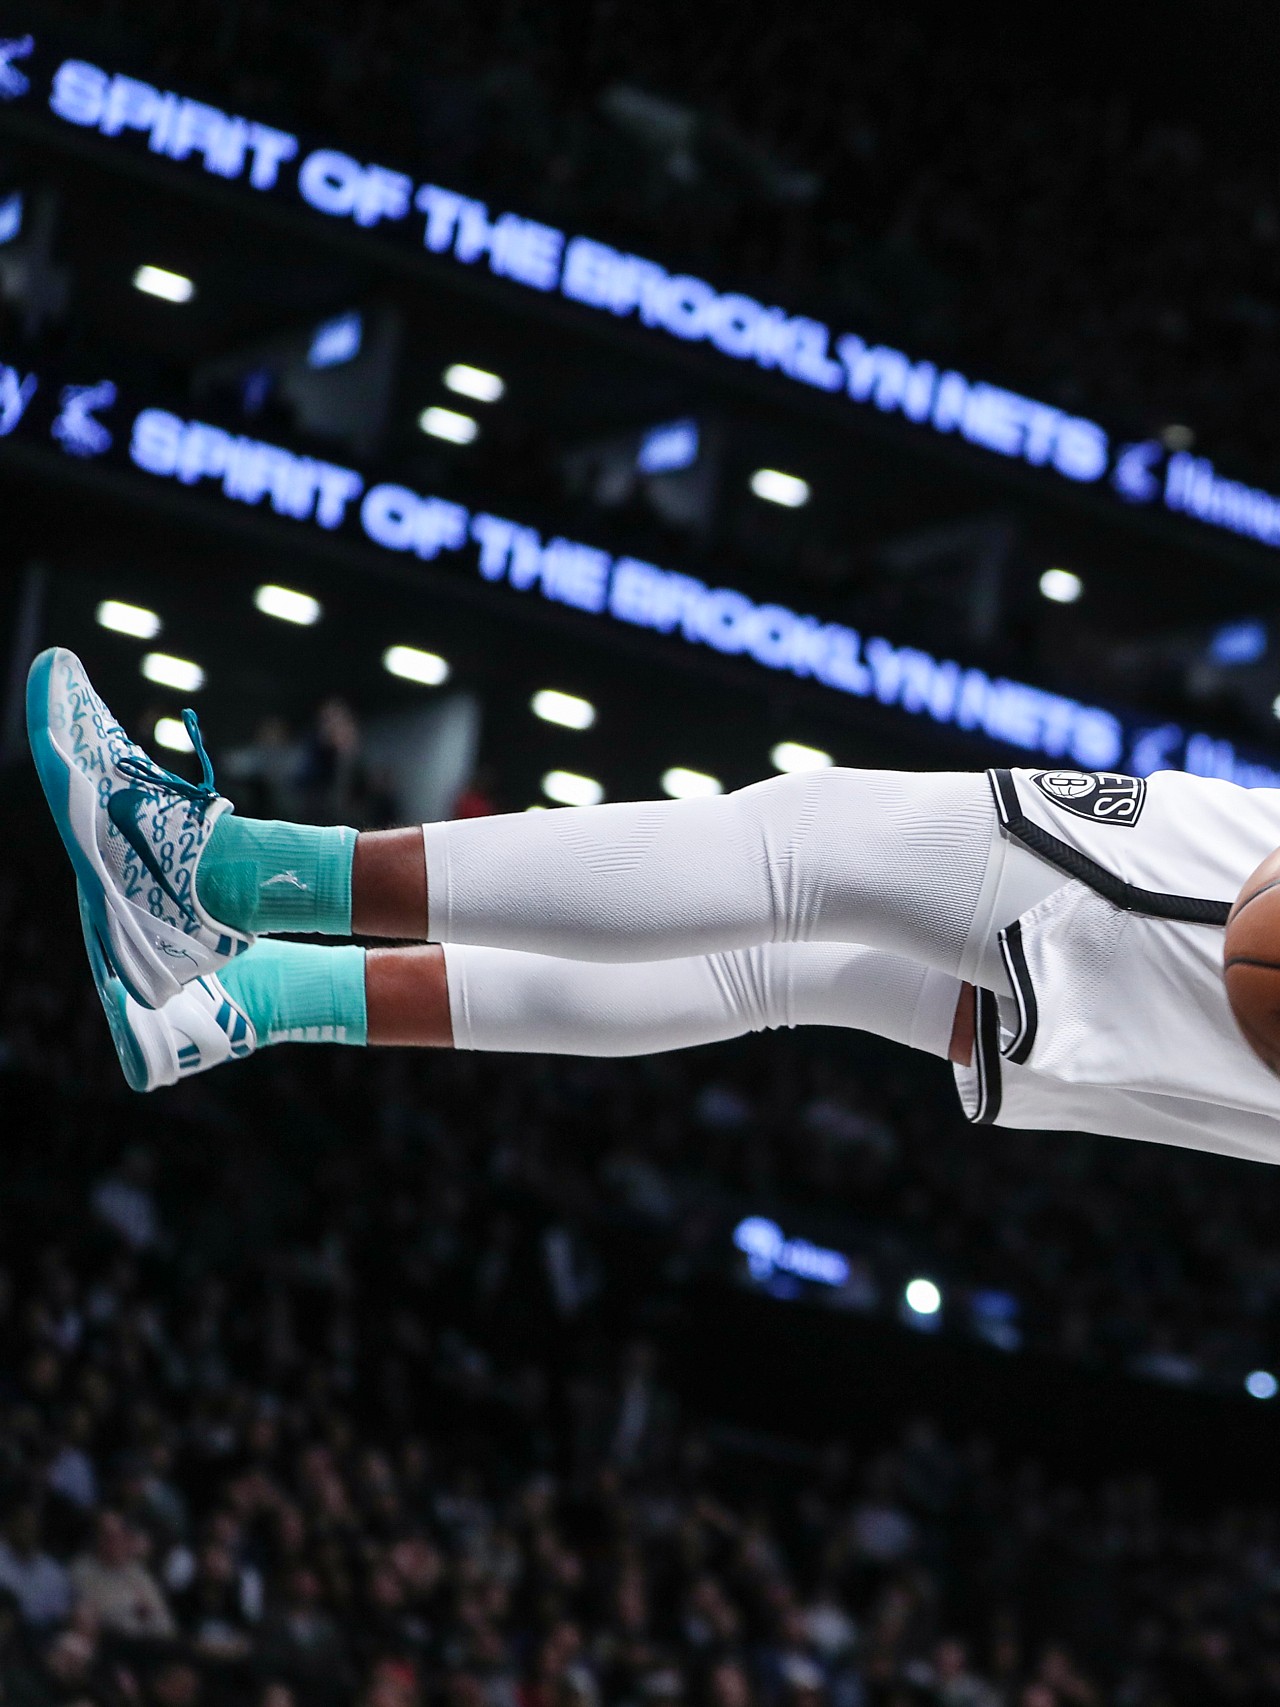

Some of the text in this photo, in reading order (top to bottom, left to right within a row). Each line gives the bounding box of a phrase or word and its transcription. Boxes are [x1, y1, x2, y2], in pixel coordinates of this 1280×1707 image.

[50, 59, 298, 190] SPIRIT
[298, 149, 412, 227] OF
[415, 184, 565, 291] THE
[561, 236, 934, 418] BROOKLYN
[934, 370, 1107, 482] NETS
[130, 408, 363, 529] SPIRIT
[361, 483, 470, 560] OF
[469, 512, 612, 609] THE
[610, 556, 957, 720] BROOKLYN
[957, 668, 1122, 769] NETS
[92, 714, 107, 739] 8
[1093, 775, 1138, 816] ETS
[152, 815, 167, 843] 8
[160, 841, 175, 873] 8
